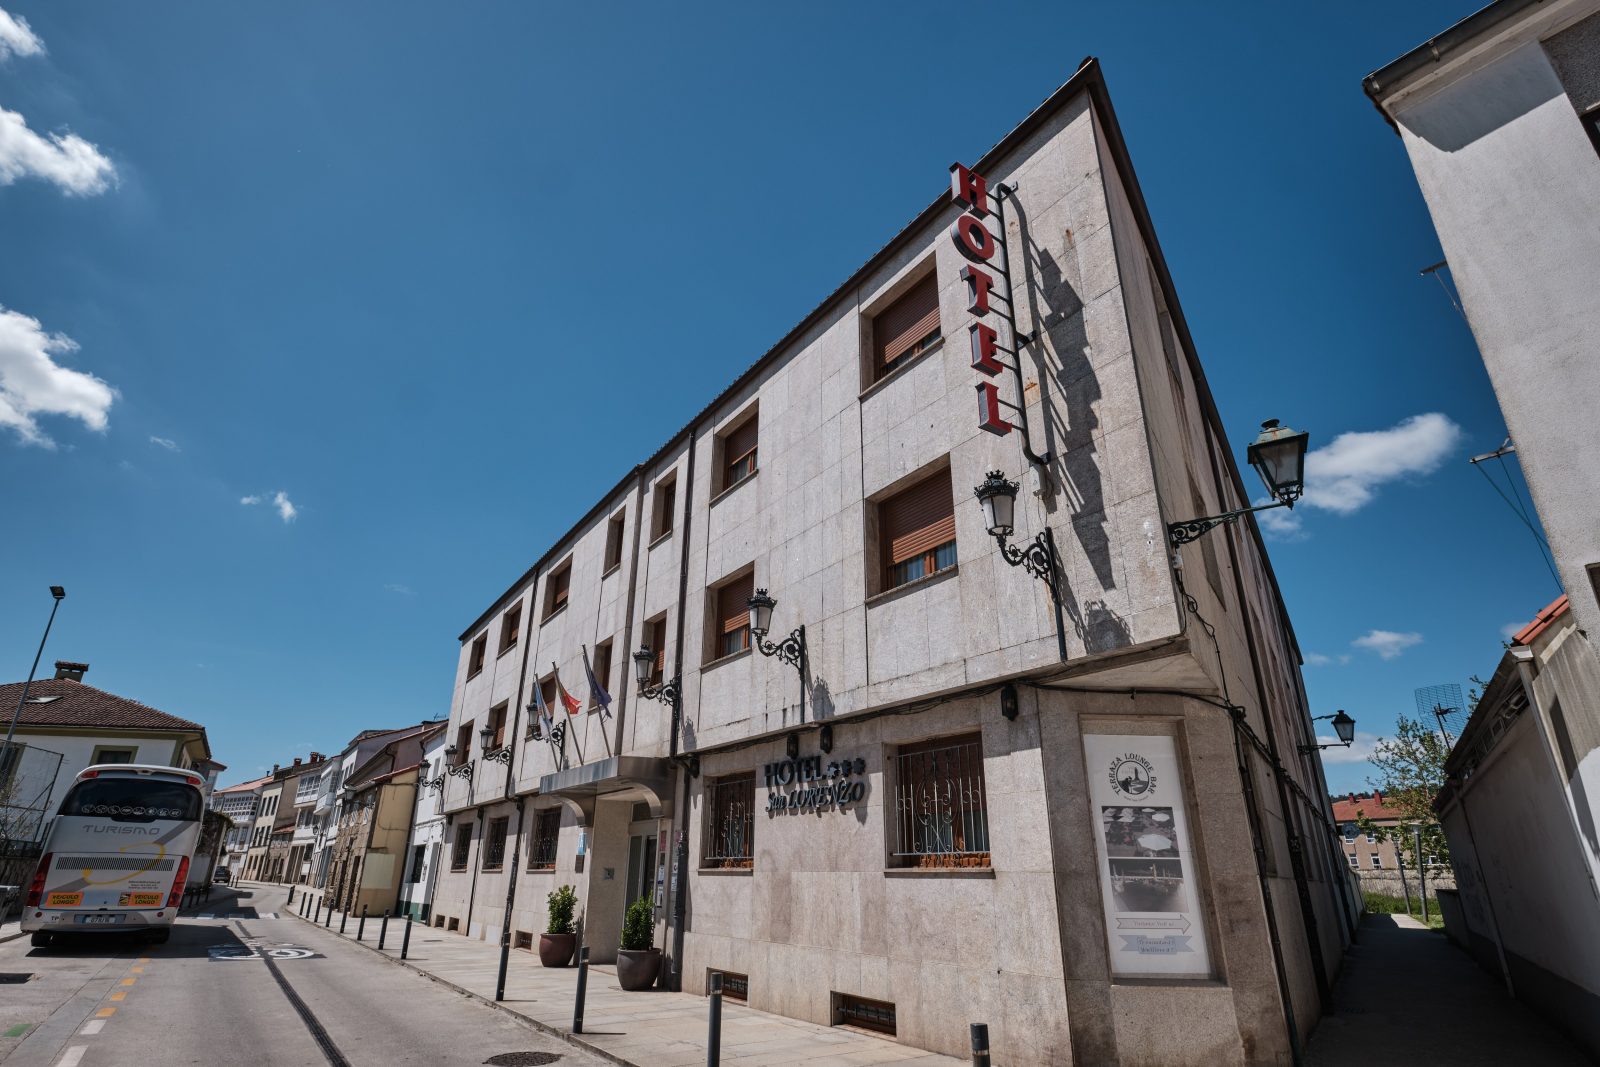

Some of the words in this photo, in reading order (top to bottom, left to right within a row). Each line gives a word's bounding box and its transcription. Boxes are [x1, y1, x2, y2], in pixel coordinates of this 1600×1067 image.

[949, 161, 1013, 437] HOTEL
[764, 755, 821, 787] HOTEL
[1108, 756, 1122, 795] TERRAZA
[1124, 752, 1154, 773] LOUNGE
[1148, 776, 1157, 795] BAR
[788, 780, 865, 809] LORENZO
[82, 824, 160, 835] TURISMO
